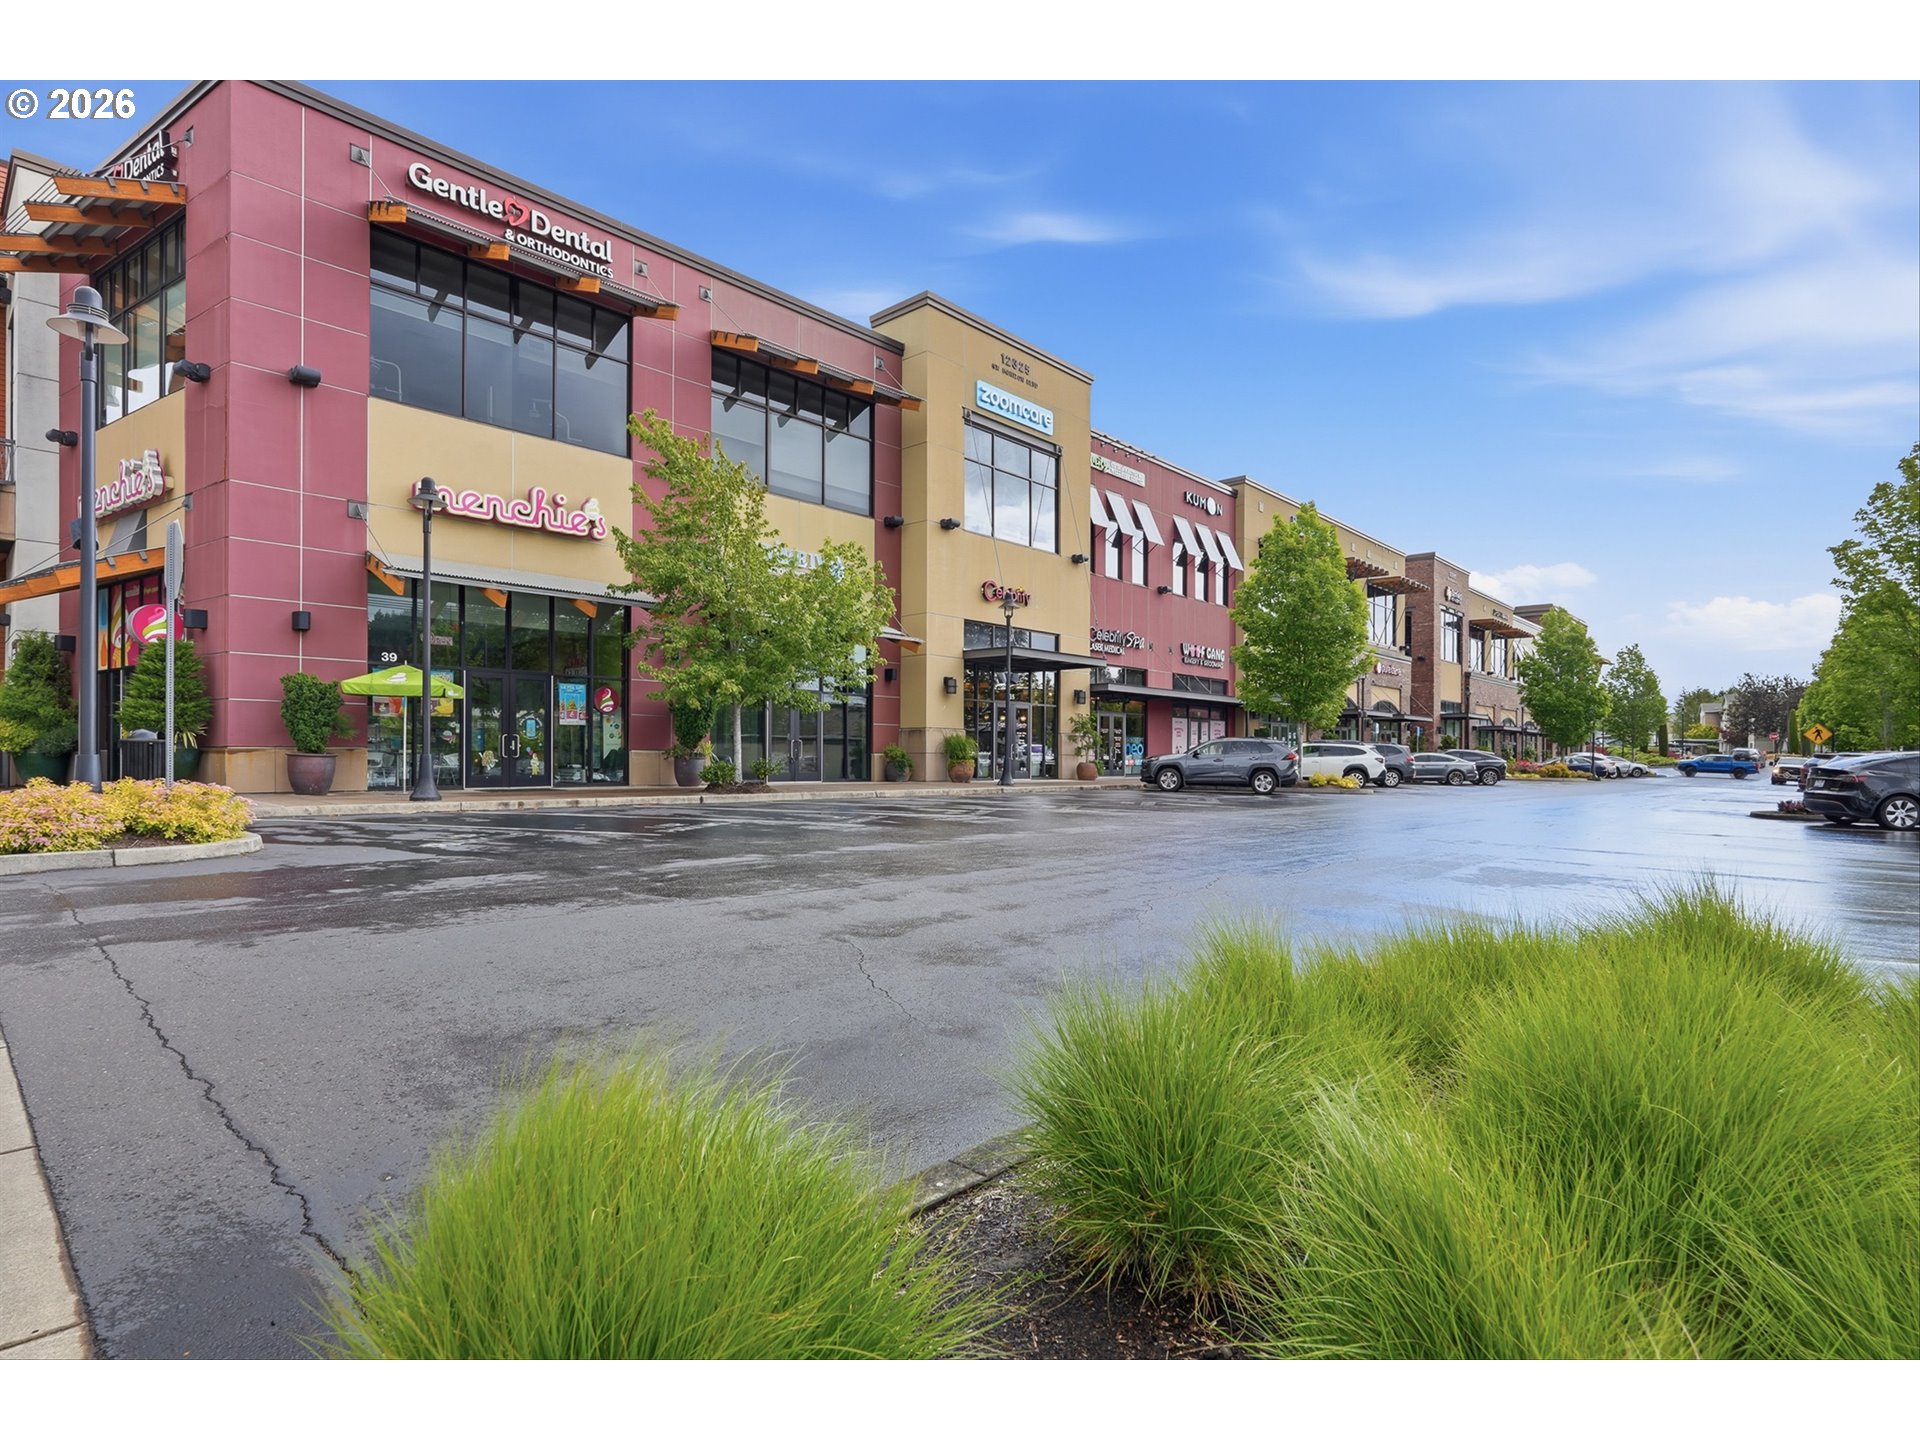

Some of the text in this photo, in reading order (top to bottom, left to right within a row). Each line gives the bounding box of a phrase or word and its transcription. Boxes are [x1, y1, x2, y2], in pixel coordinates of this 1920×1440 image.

[124, 130, 164, 178] Dental
[408, 162, 613, 263] Gentle Dental
[504, 228, 614, 279] & ORTHODONTICS
[1185, 491, 1223, 517] KUMON
[381, 651, 398, 662] 39
